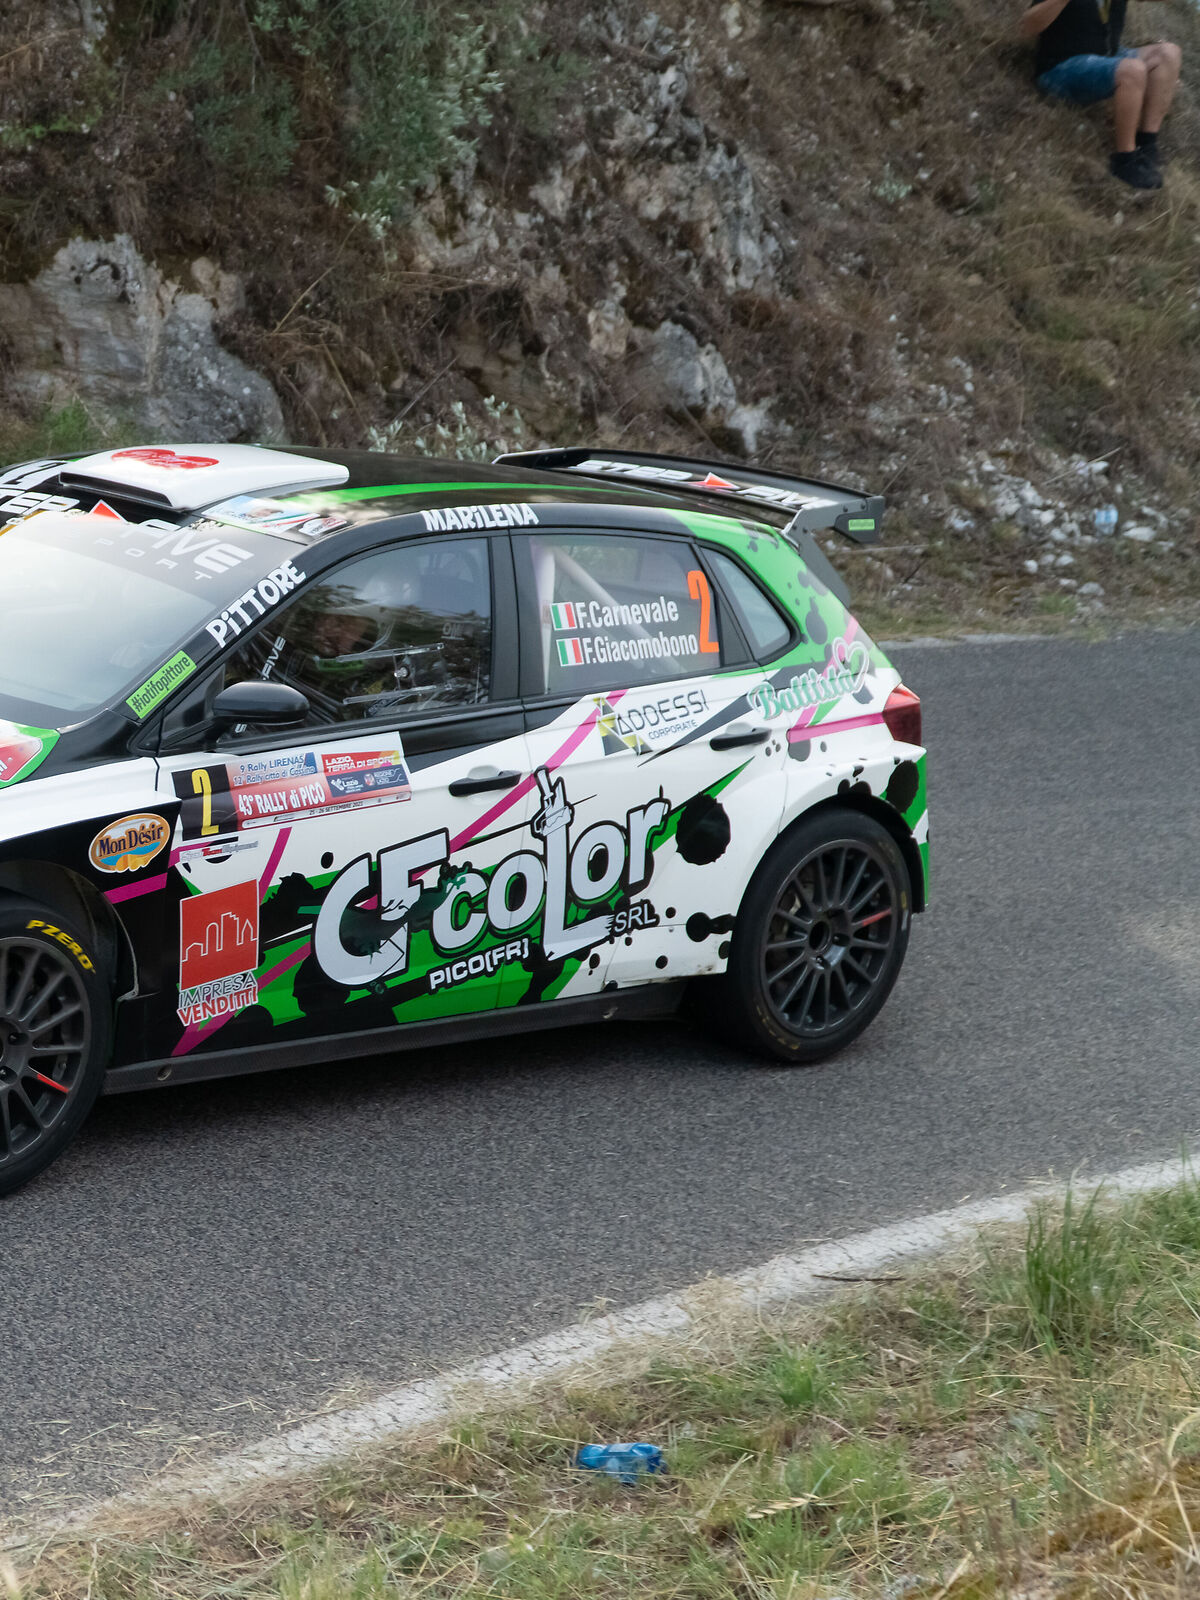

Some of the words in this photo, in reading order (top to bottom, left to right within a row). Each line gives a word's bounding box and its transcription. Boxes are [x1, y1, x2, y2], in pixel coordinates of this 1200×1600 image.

[576, 596, 679, 629] F.Carnevale
[687, 570, 719, 653] 2
[582, 631, 698, 664] F.Giacomobono
[648, 720, 698, 740] CORPORATE
[247, 761, 267, 772] Rally
[269, 755, 304, 769] LIRENAS
[326, 762, 356, 773] TERRA
[356, 760, 365, 768] DI
[191, 769, 219, 837] 2
[255, 791, 288, 814] RALLY
[289, 789, 301, 809] di
[299, 781, 326, 806] PICO
[325, 803, 352, 813] SETTEMBRE
[98, 837, 127, 857] Mon
[127, 824, 164, 849] Désir
[614, 904, 656, 933] SRL
[179, 970, 257, 1008] IMPRESA
[177, 986, 258, 1026] VENDITTI
